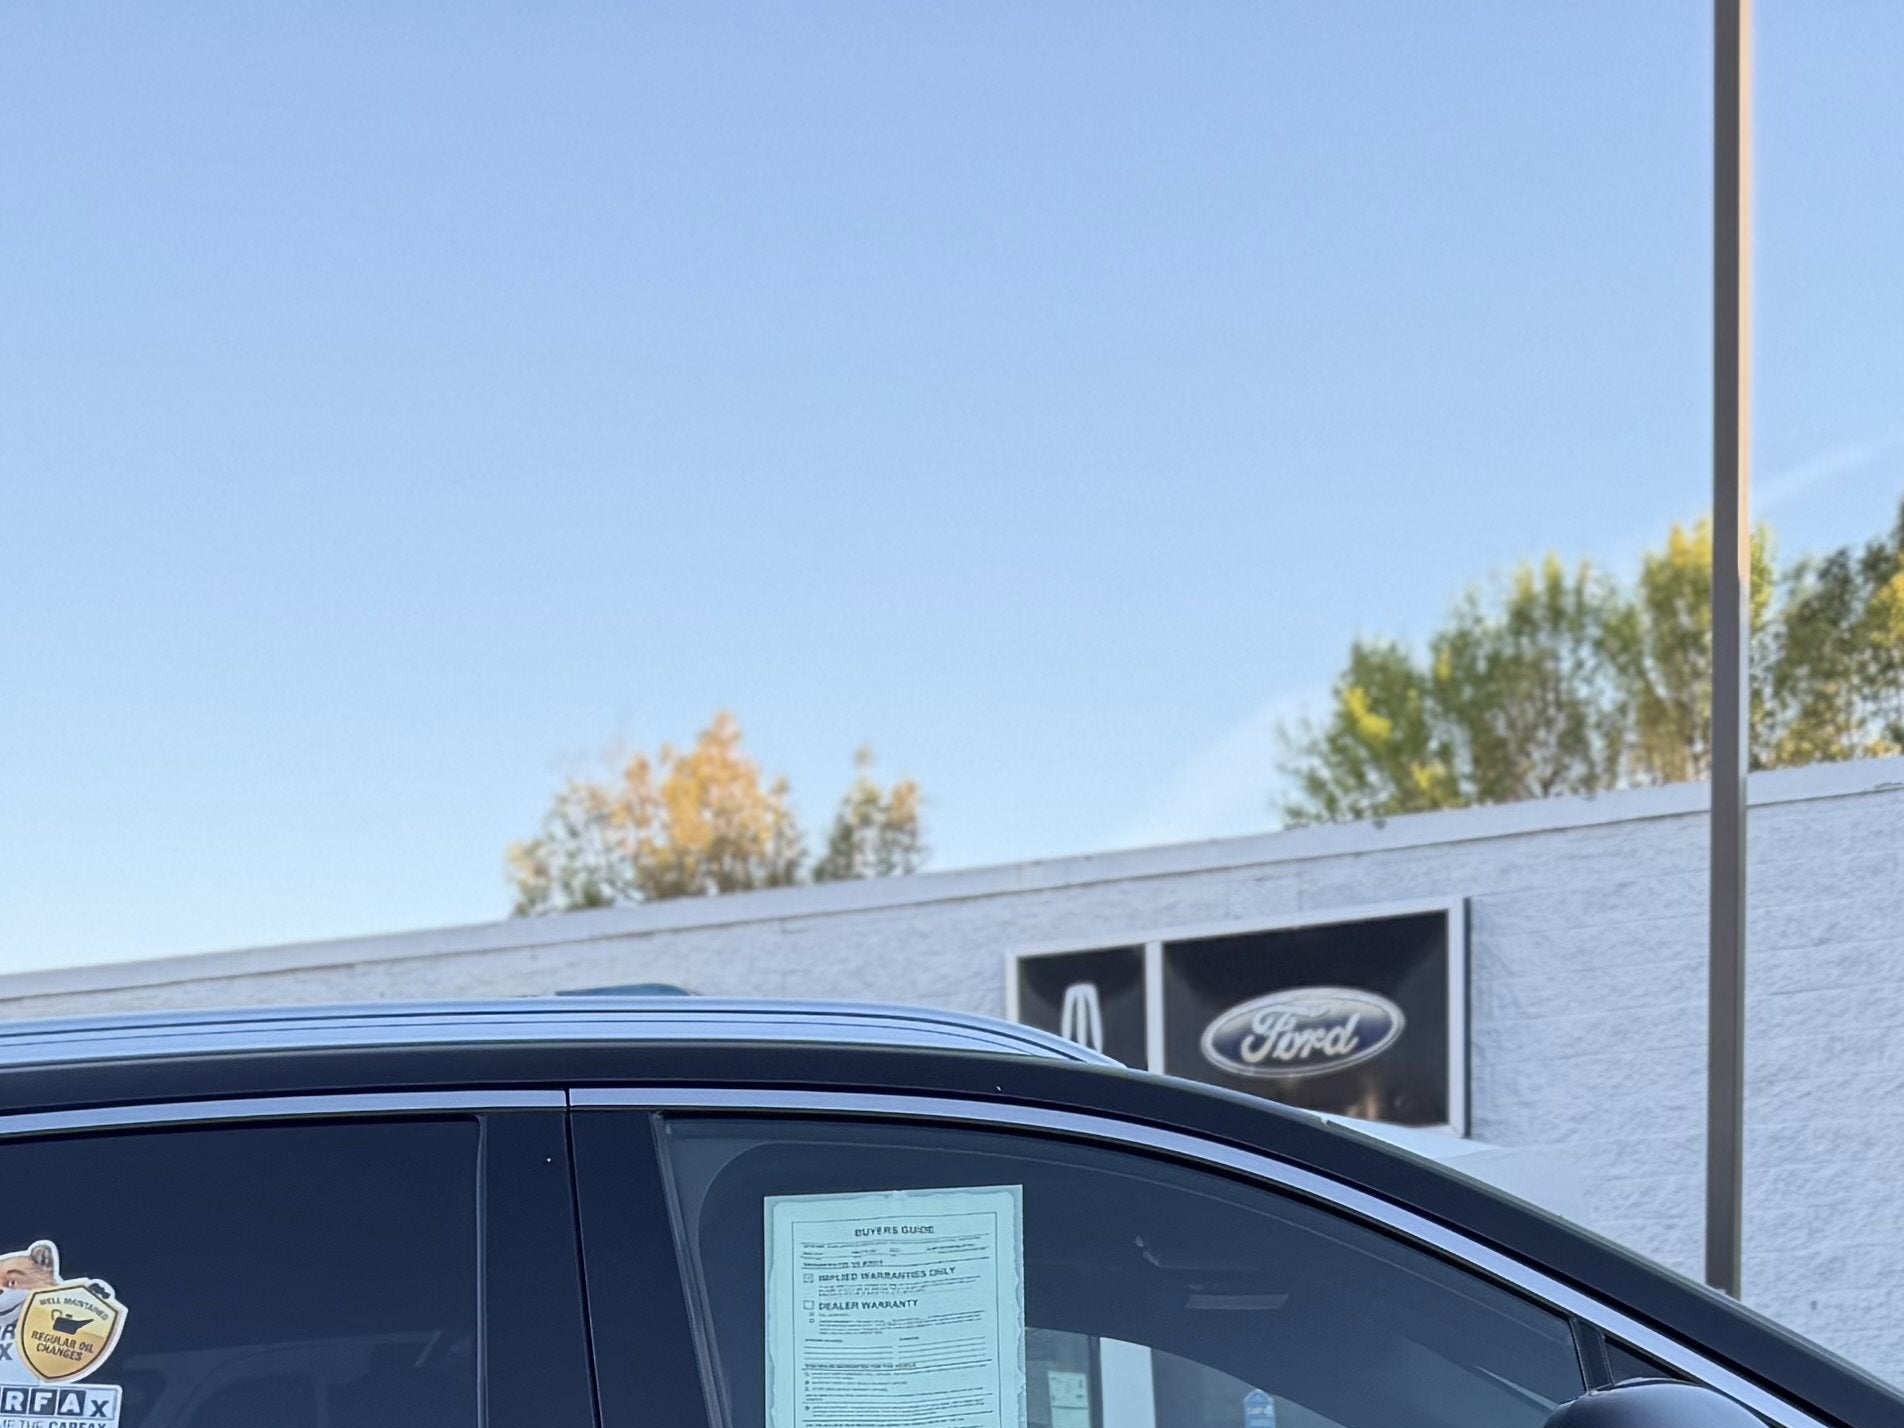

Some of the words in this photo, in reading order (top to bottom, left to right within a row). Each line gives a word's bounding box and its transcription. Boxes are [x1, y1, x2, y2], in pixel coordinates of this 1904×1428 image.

[1240, 1003, 1361, 1064] Ford
[39, 1297, 61, 1306] WELL
[818, 1302, 859, 1311] DEALER
[861, 1299, 919, 1310] WARRANTY
[30, 1330, 77, 1349] REGULAR
[78, 1341, 95, 1354] OIL
[35, 1342, 83, 1362] CHANGES
